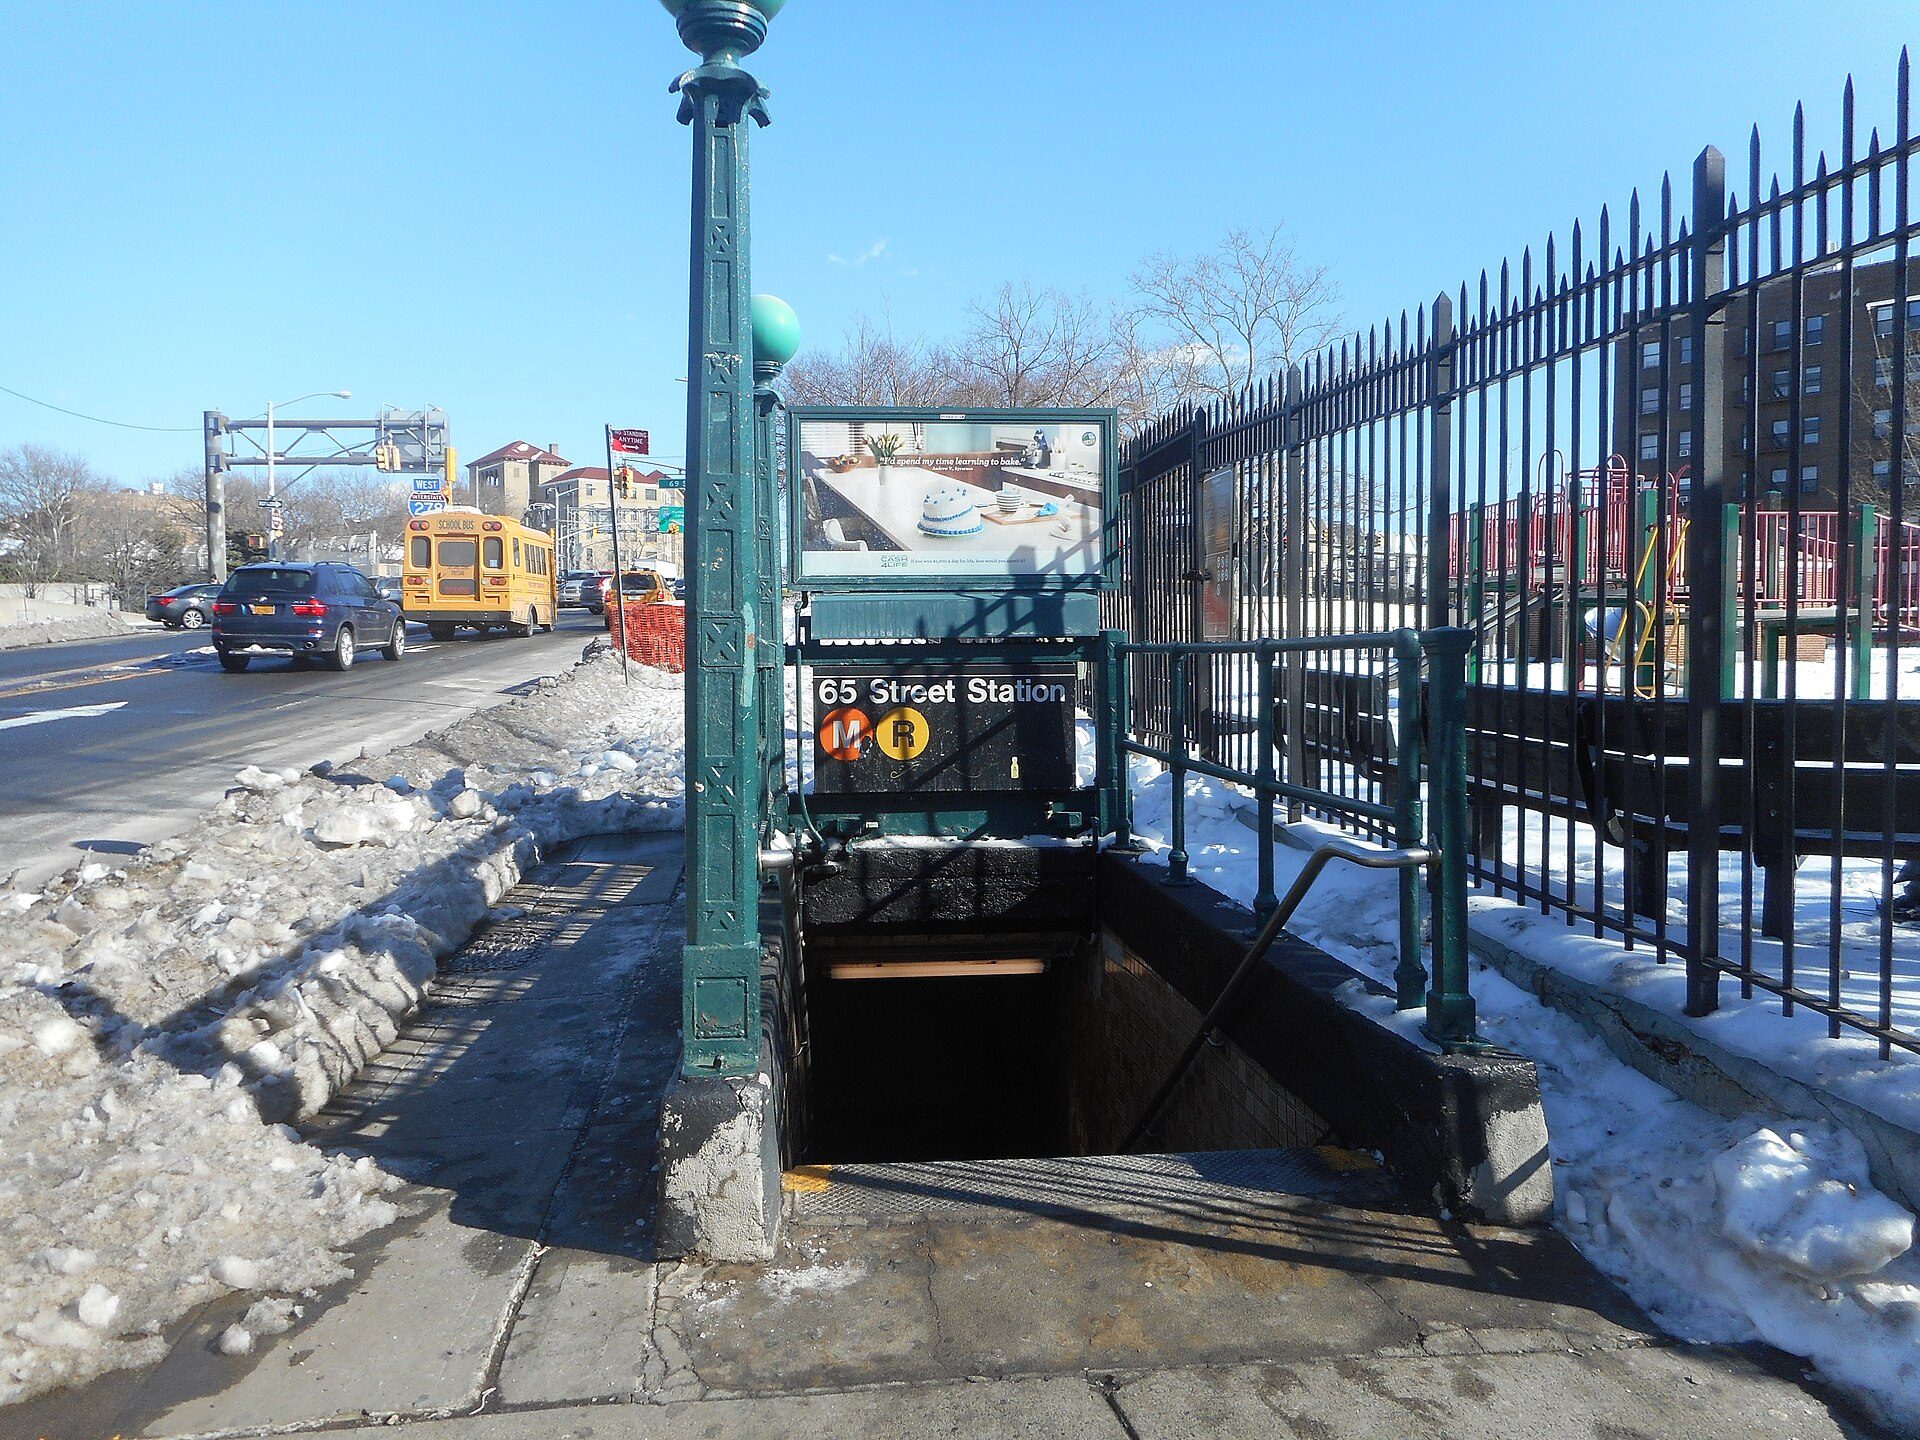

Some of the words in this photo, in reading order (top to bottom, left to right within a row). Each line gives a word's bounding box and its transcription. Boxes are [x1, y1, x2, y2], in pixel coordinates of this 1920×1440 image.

[618, 436, 643, 444] ANYTIME
[896, 457, 921, 466] spend
[955, 457, 989, 467] learning
[416, 480, 437, 490] WEST
[438, 520, 460, 529] SCHOOL
[462, 520, 475, 529] BUS
[818, 678, 858, 704] 65
[869, 678, 956, 704] Street
[967, 678, 1066, 703] Station
[832, 720, 861, 749] M
[892, 720, 915, 748] R
